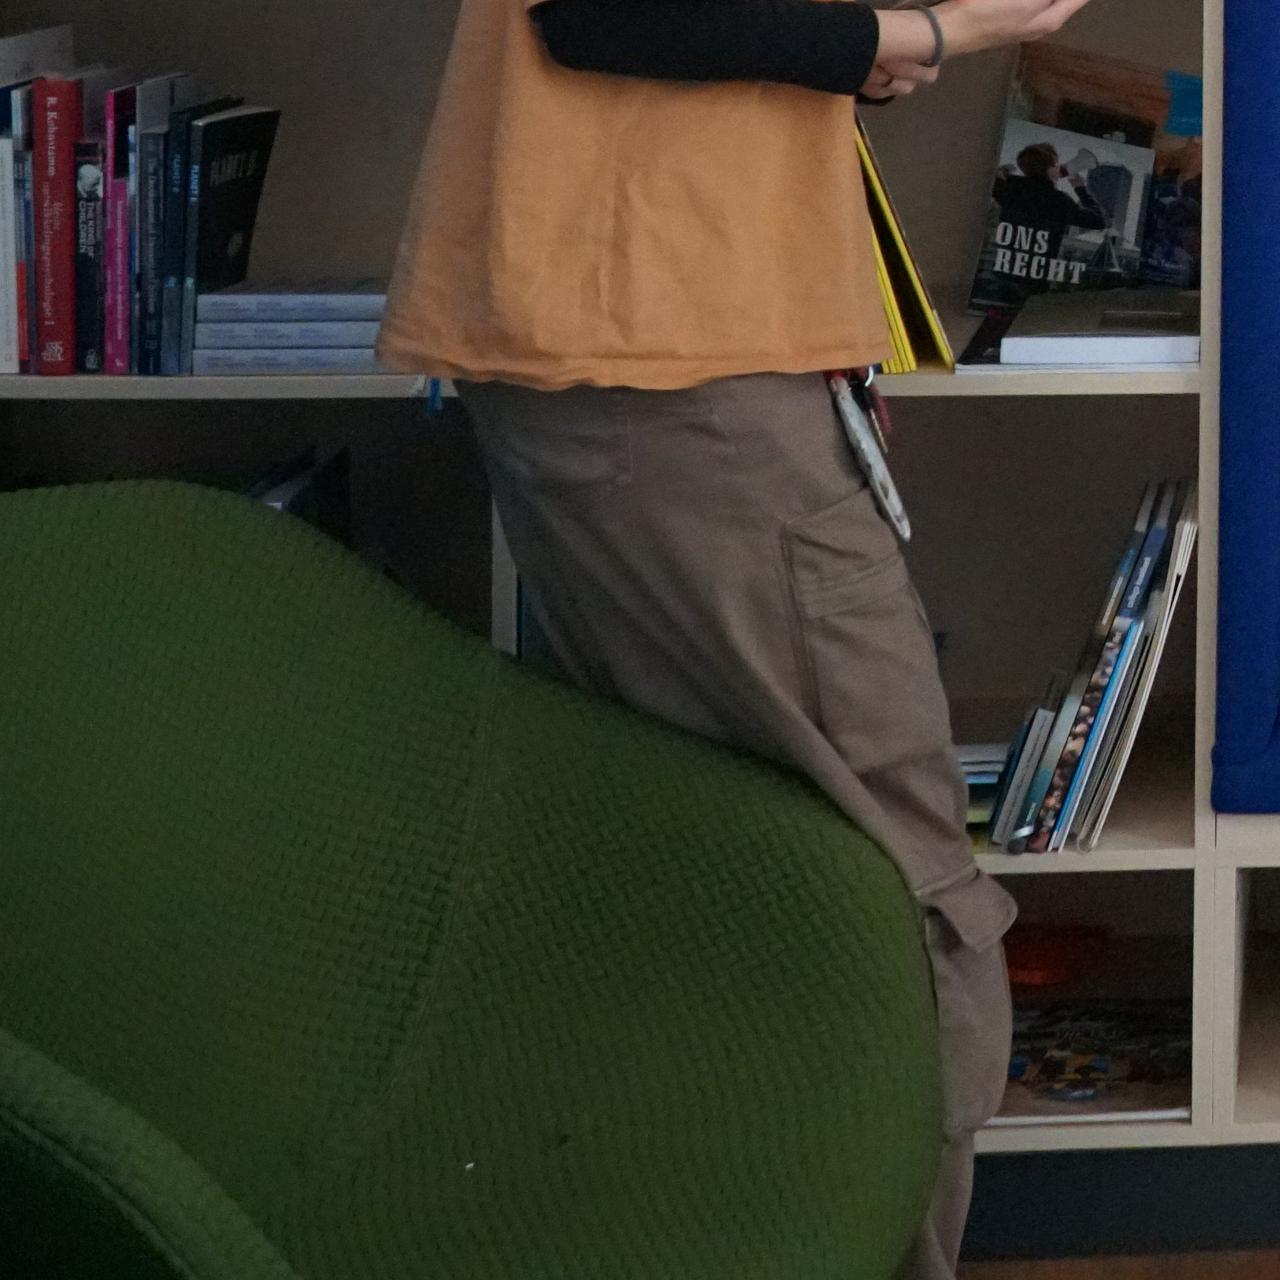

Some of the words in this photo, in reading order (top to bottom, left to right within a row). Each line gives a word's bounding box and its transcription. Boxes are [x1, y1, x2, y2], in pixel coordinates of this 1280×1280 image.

[78, 201, 87, 253] CHILDREN
[995, 221, 1050, 254] ONS
[993, 248, 1087, 284] RECHT
